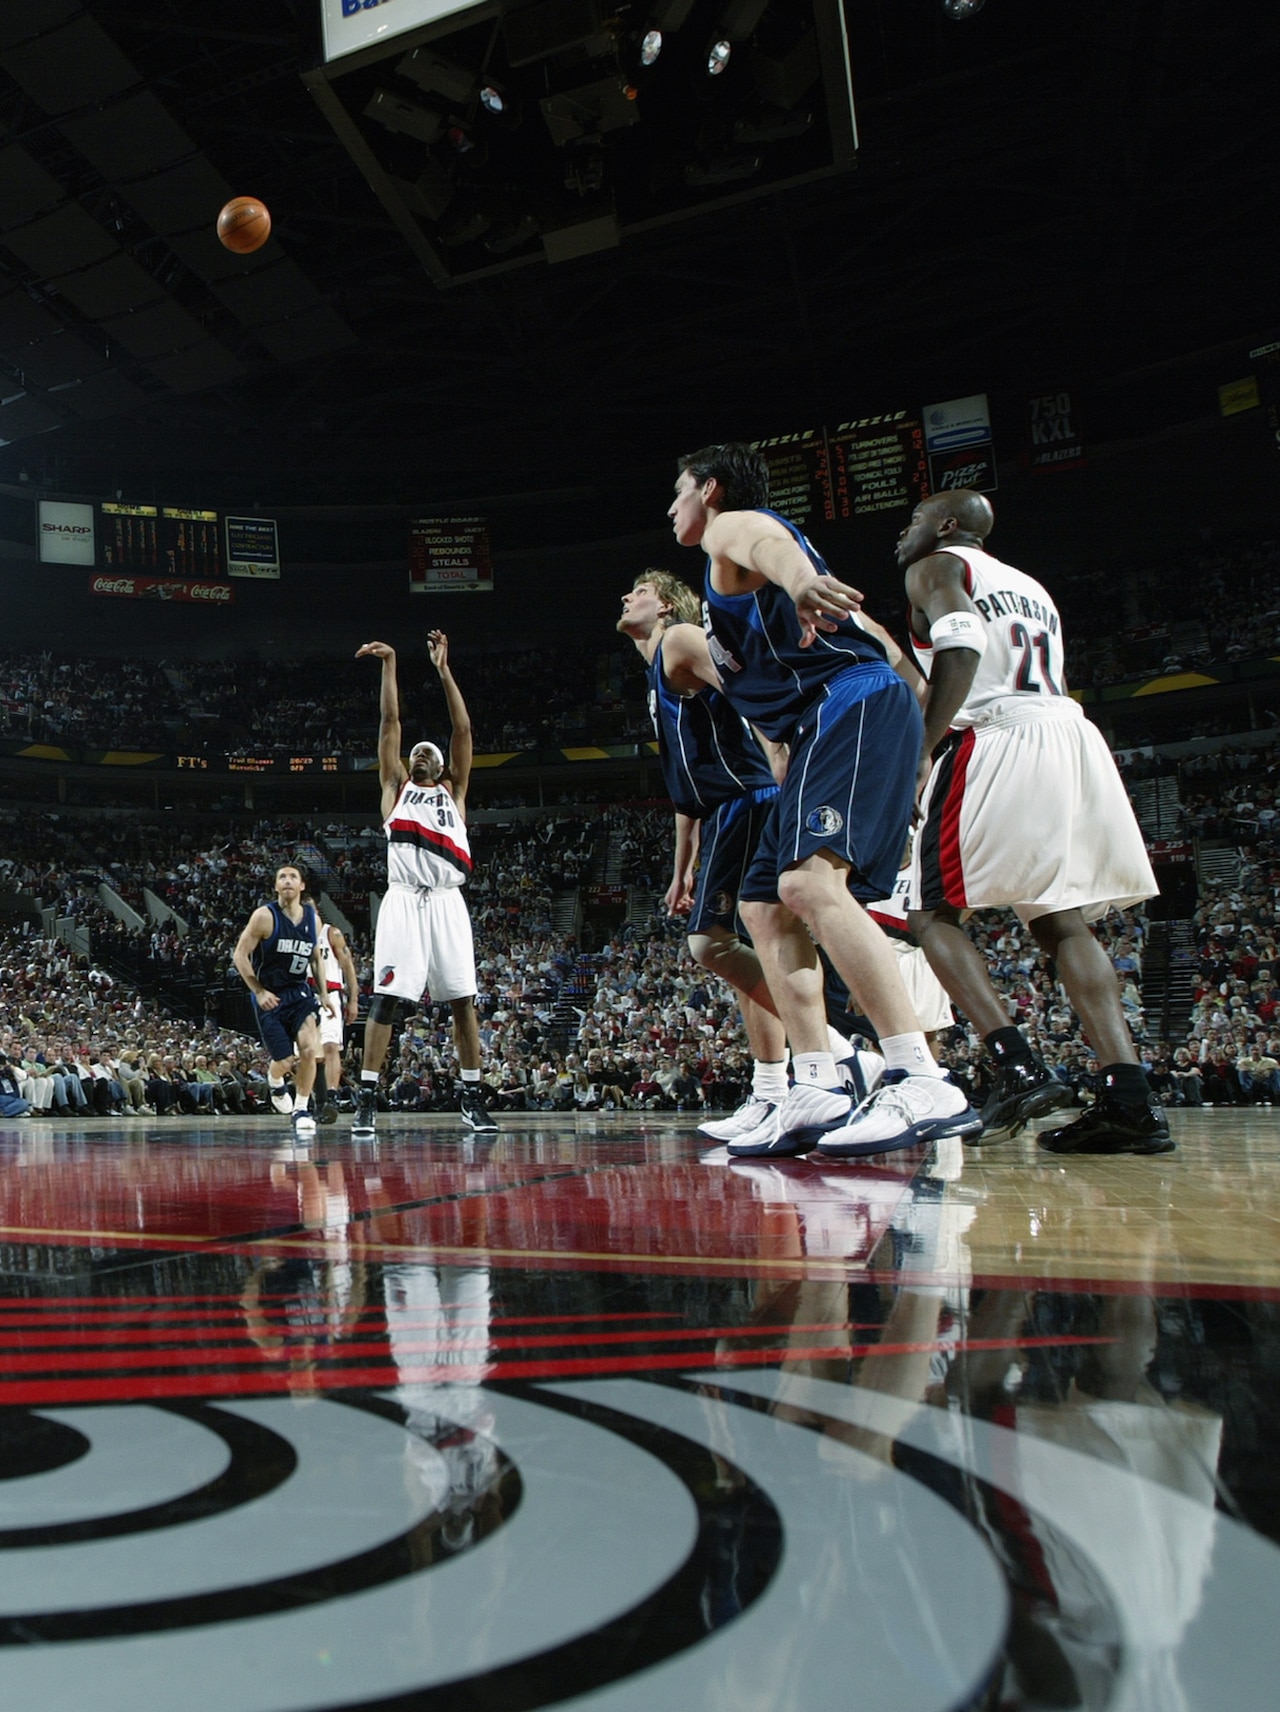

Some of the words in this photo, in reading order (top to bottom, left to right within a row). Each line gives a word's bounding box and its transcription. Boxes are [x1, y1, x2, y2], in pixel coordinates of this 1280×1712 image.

[1028, 392, 1071, 421] 750
[837, 410, 907, 432] FIZZLE
[1031, 416, 1076, 445] KXL
[851, 434, 899, 450] TURNOVERS
[940, 461, 988, 488] Pizza
[948, 472, 983, 491] Hut
[862, 478, 897, 491] FOULS
[854, 493, 872, 504] AIR
[873, 486, 908, 500] BALLS
[855, 497, 909, 514] GOALTENDING
[42, 523, 91, 534] SHARP
[425, 536, 453, 544] BLOCKED
[429, 547, 472, 556] REBOUNDS
[432, 558, 470, 567] STEALS
[437, 571, 466, 579] TOTAL
[974, 590, 1059, 636] PATTERSON
[1010, 622, 1062, 695] 21
[177, 756, 208, 769] FT's
[437, 808, 455, 828] 30
[276, 938, 314, 957] DALLAS
[288, 954, 309, 975] 13
